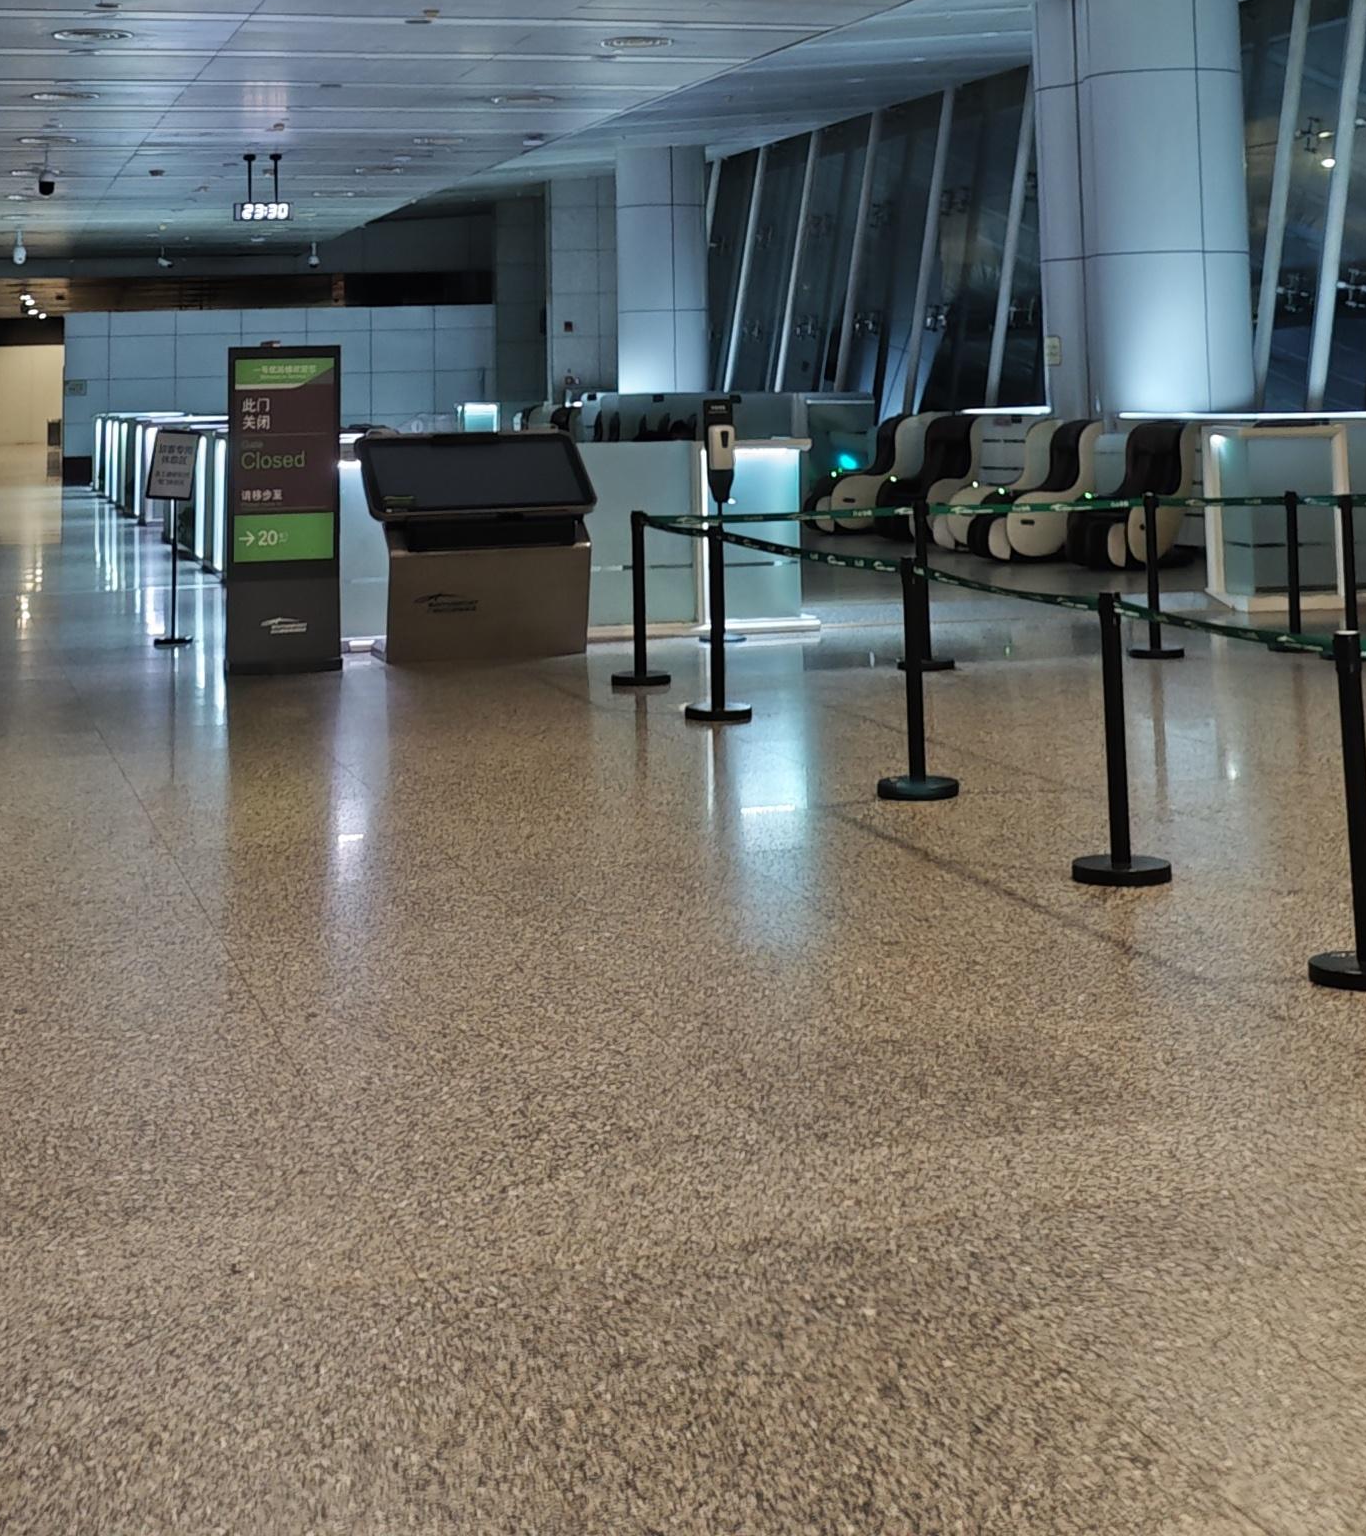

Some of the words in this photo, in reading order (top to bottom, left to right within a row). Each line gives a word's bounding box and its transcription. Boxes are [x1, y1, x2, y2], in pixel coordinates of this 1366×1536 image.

[241, 202, 289, 220] 23:30
[241, 397, 270, 413] 此门
[242, 415, 270, 430] 关闭
[241, 451, 306, 470] Closed
[258, 530, 278, 546] 20
